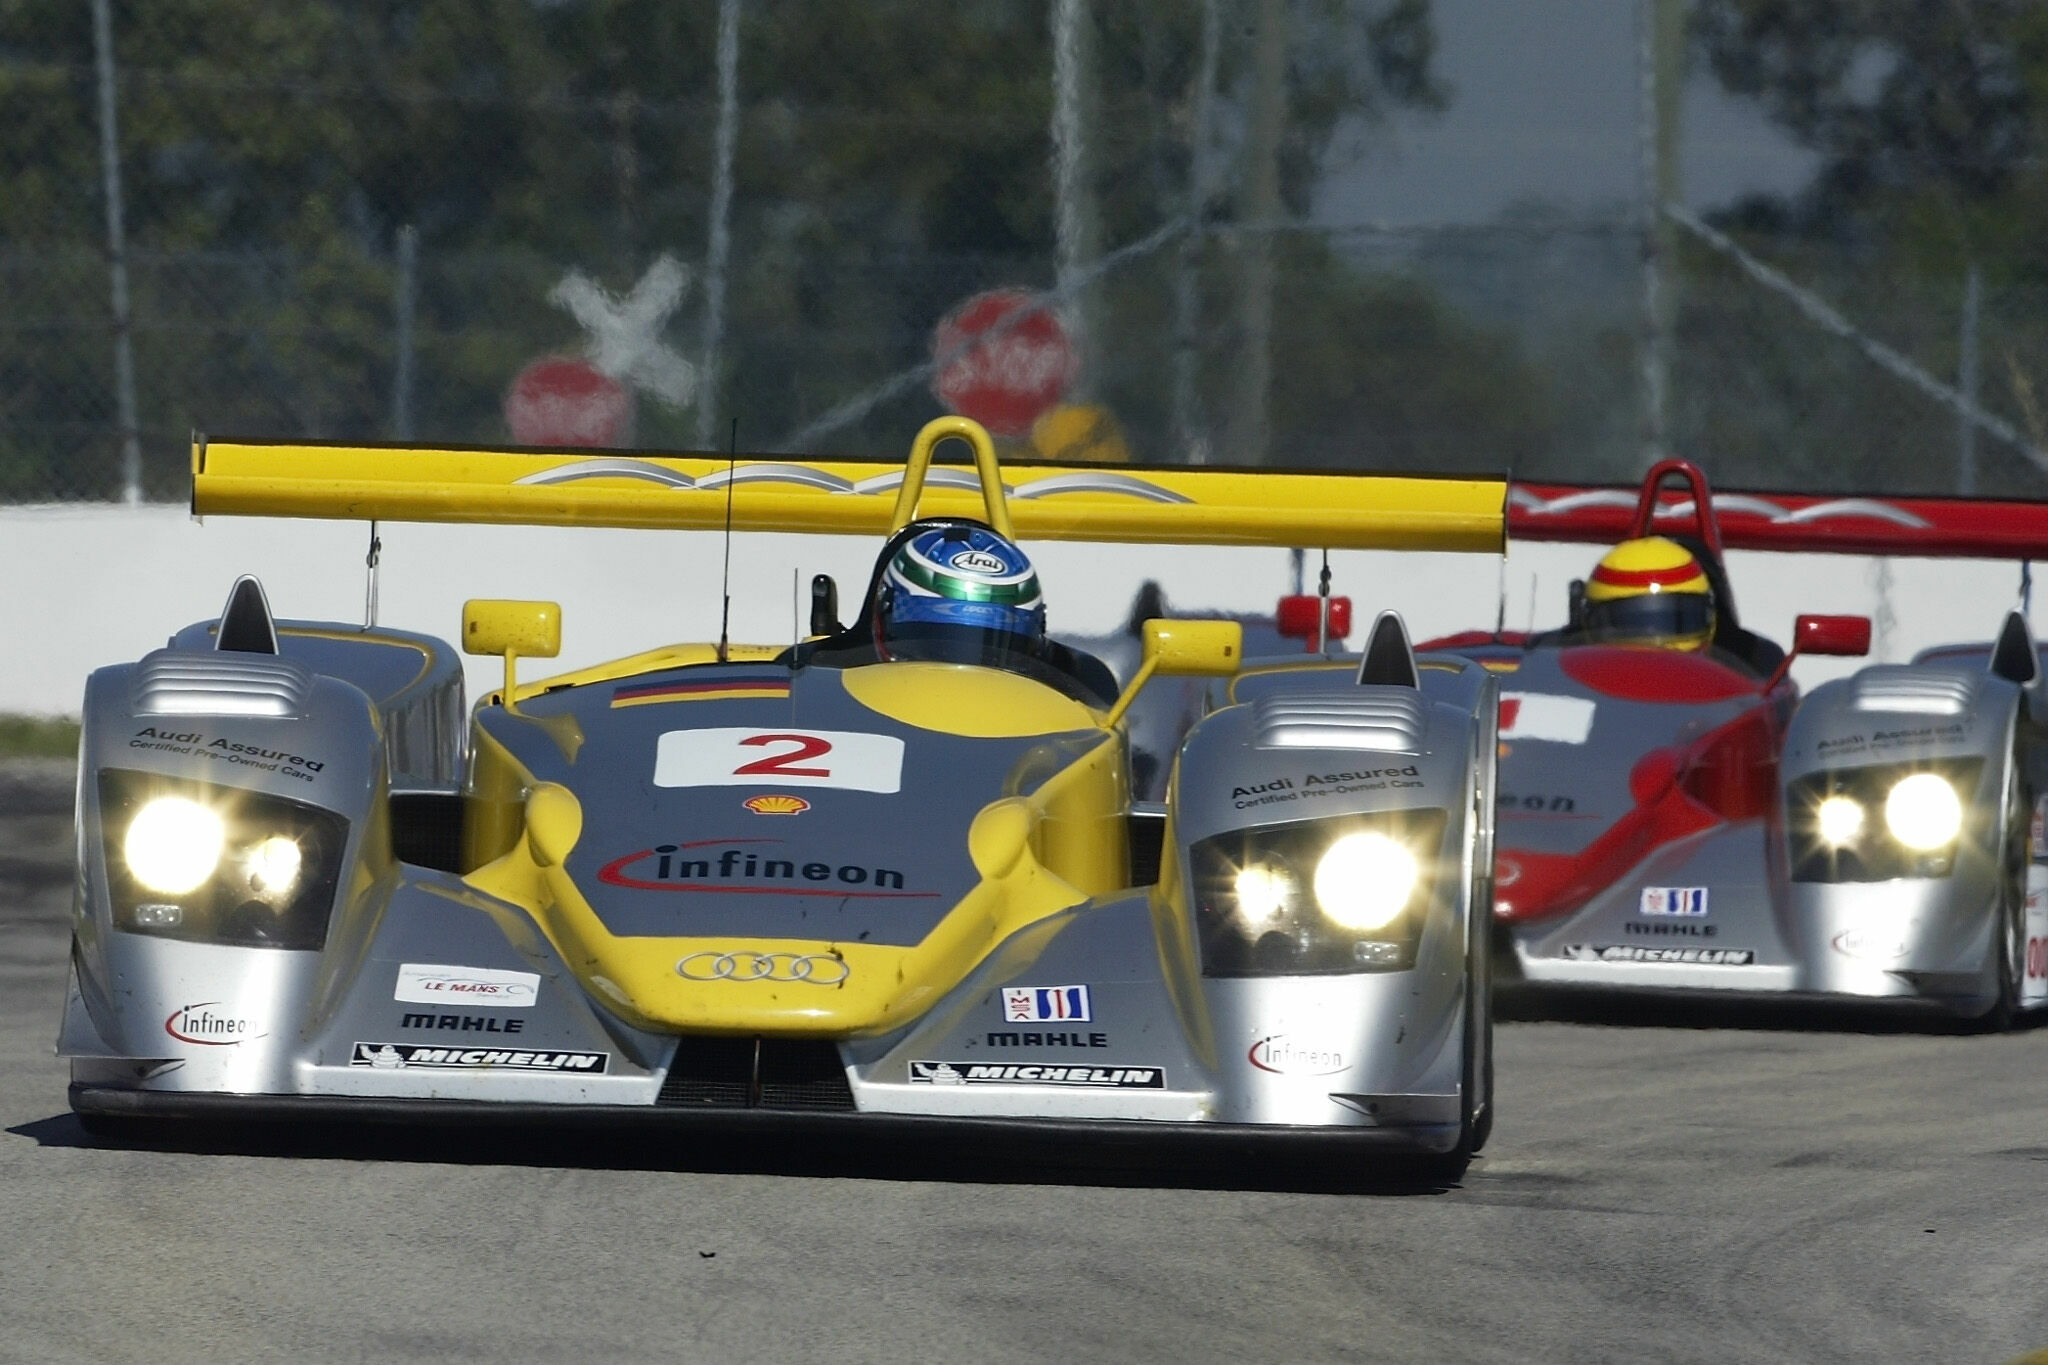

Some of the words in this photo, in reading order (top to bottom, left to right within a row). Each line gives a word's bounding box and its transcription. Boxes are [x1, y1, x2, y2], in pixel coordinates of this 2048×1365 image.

[963, 552, 999, 569] Arai
[129, 739, 192, 755] Certified
[194, 748, 279, 772] Pre-Owned
[281, 766, 314, 782] Cars
[136, 727, 203, 744] Audi
[208, 738, 325, 773] Assured
[732, 734, 832, 777] 2
[1231, 777, 1293, 799] Audi
[1304, 765, 1420, 787] Assured
[1234, 791, 1298, 810] Certified
[1301, 780, 1387, 799] Pre-Owned
[1391, 779, 1425, 789] Cars
[1624, 920, 1718, 937] MAHLE
[424, 982, 446, 991] LE
[449, 983, 500, 994] MANS
[401, 1012, 525, 1034] MAHLE
[987, 1032, 1108, 1048] MAHLE
[408, 1048, 599, 1070] MICHELIN
[966, 1064, 1155, 1084] MICHELIN
